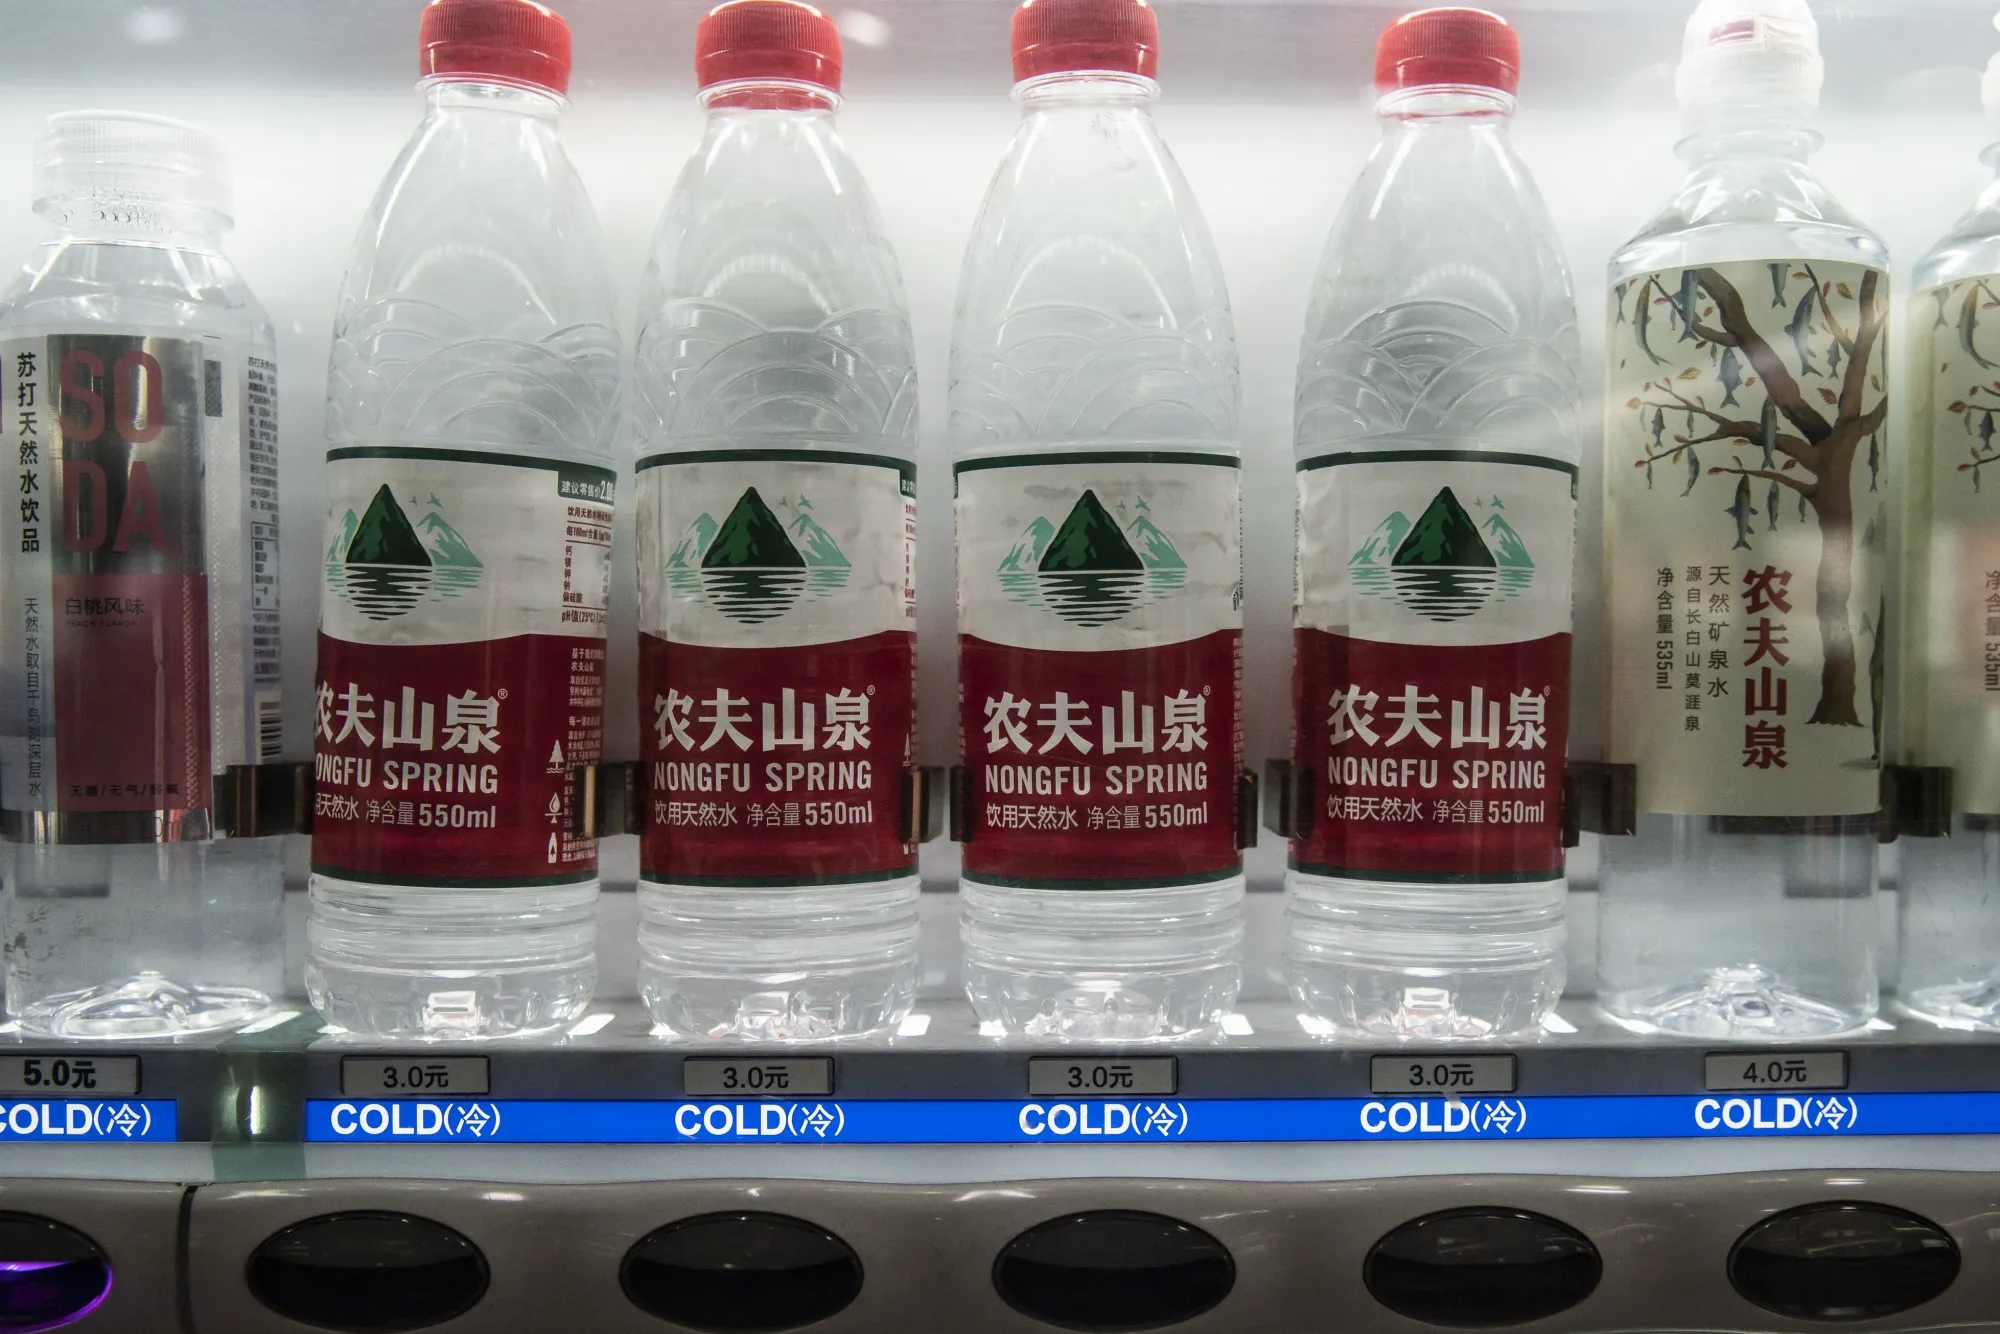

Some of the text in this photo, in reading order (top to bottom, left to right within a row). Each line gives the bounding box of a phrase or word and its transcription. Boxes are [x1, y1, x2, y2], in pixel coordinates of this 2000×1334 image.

[17, 352, 40, 553] 苏打天然水饮品
[65, 597, 145, 617] 白桃风味
[1707, 565, 1730, 698] 天然矿泉水
[1684, 566, 1702, 732] 源自长白山莫涯泉
[1741, 565, 1793, 770] 农夫山泉
[315, 679, 502, 754] 农夫山泉
[654, 687, 872, 752] 农夫山泉
[983, 688, 1208, 755] 农夫山泉
[1326, 684, 1547, 750] 农夫山泉
[316, 752, 498, 794] ONGFU SPRING
[654, 760, 872, 792] NONGFU SPRING
[985, 761, 1207, 795] NONGFU SPRING
[1328, 756, 1545, 789] NONGFU SPRING
[655, 801, 738, 827] 饮用天然水
[986, 802, 1078, 830] 饮用天然水
[1327, 793, 1424, 822] 饮用天然水
[23, 1059, 97, 1089] 5.0元
[383, 1065, 449, 1089] 3.0元
[722, 1066, 789, 1089] 3.0元
[1067, 1065, 1133, 1089] 3.0元
[1409, 1063, 1474, 1087] 3.0元
[1742, 1060, 1807, 1083] 4.0元
[0, 1103, 151, 1138] OLD(冷)
